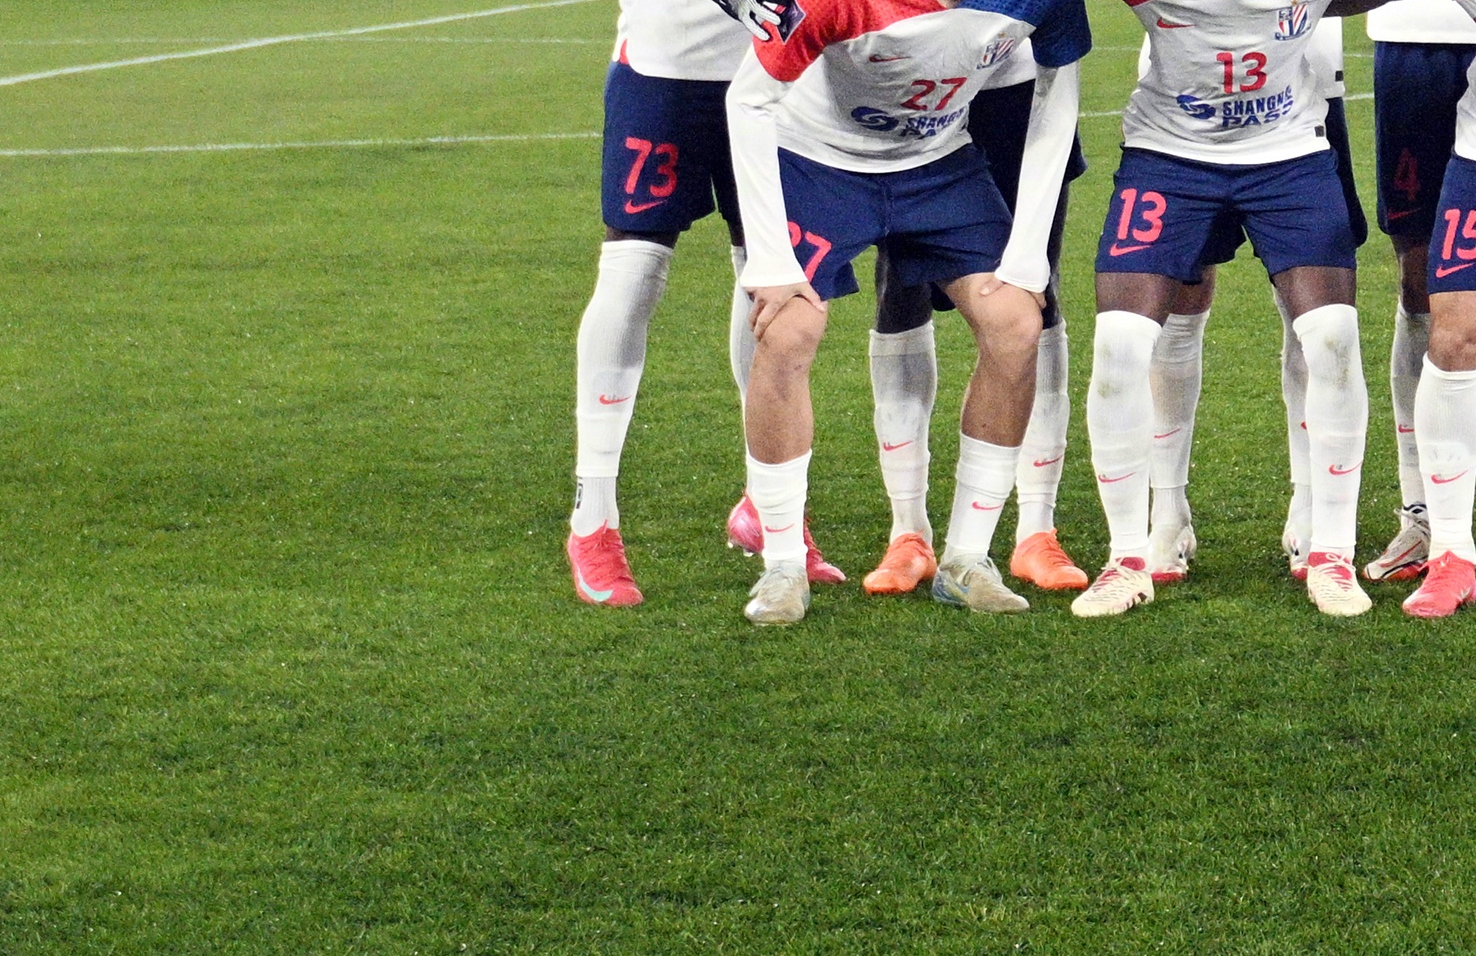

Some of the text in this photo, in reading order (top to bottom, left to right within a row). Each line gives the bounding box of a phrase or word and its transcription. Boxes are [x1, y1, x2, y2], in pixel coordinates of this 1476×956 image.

[901, 77, 967, 111] 27
[1216, 52, 1268, 95] 13
[1222, 100, 1294, 129] PASS
[624, 135, 679, 198] 73
[1117, 187, 1167, 243] 13
